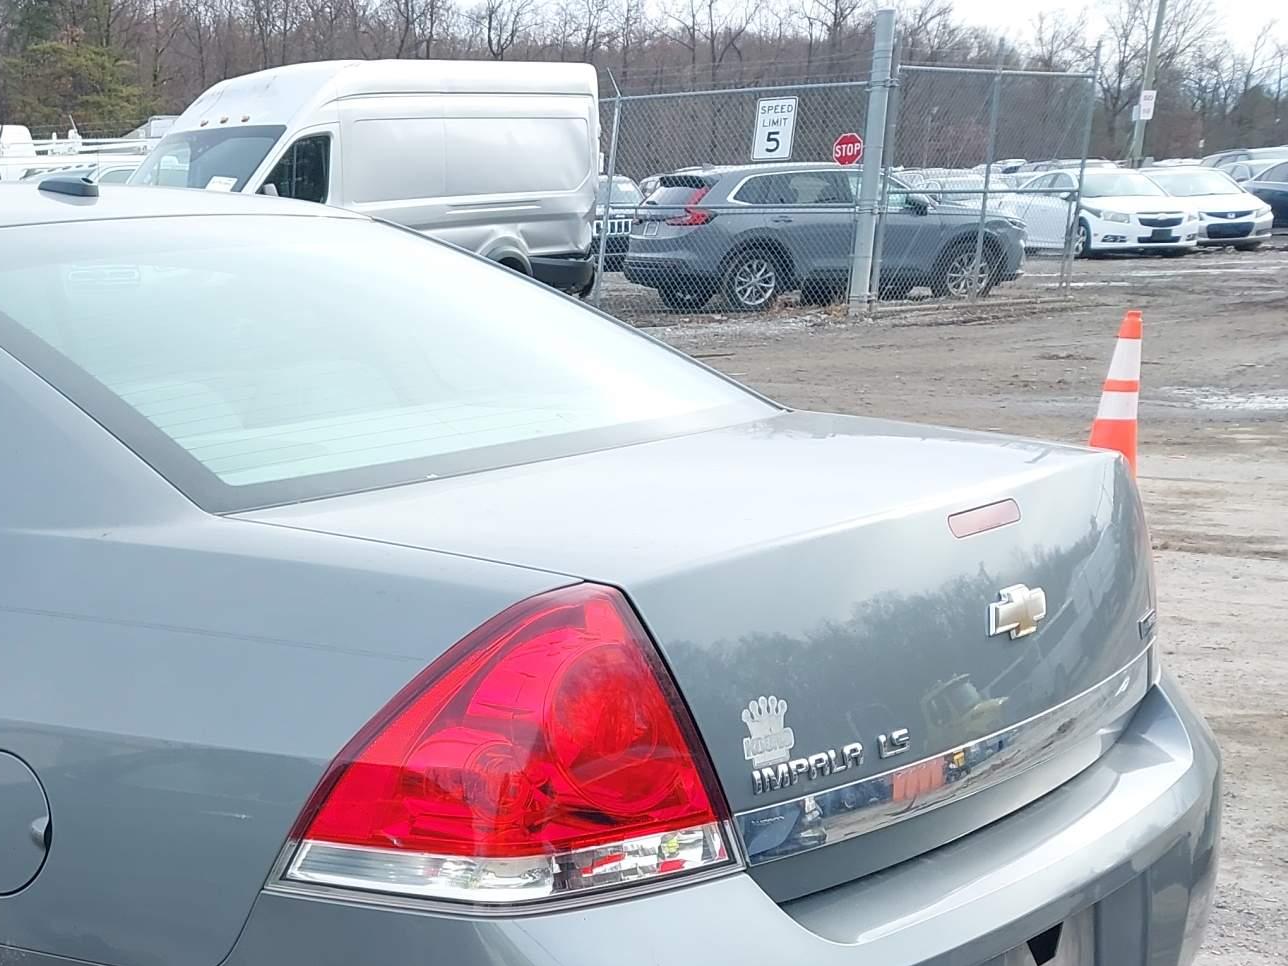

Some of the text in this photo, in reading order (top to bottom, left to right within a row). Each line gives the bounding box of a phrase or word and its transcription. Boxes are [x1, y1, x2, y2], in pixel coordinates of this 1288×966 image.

[760, 104, 794, 115] SPEED
[762, 117, 789, 127] LIMIT
[765, 131, 780, 153] 5
[834, 143, 861, 157] STOP
[751, 742, 864, 795] IMPALA
[877, 728, 911, 759] LS
